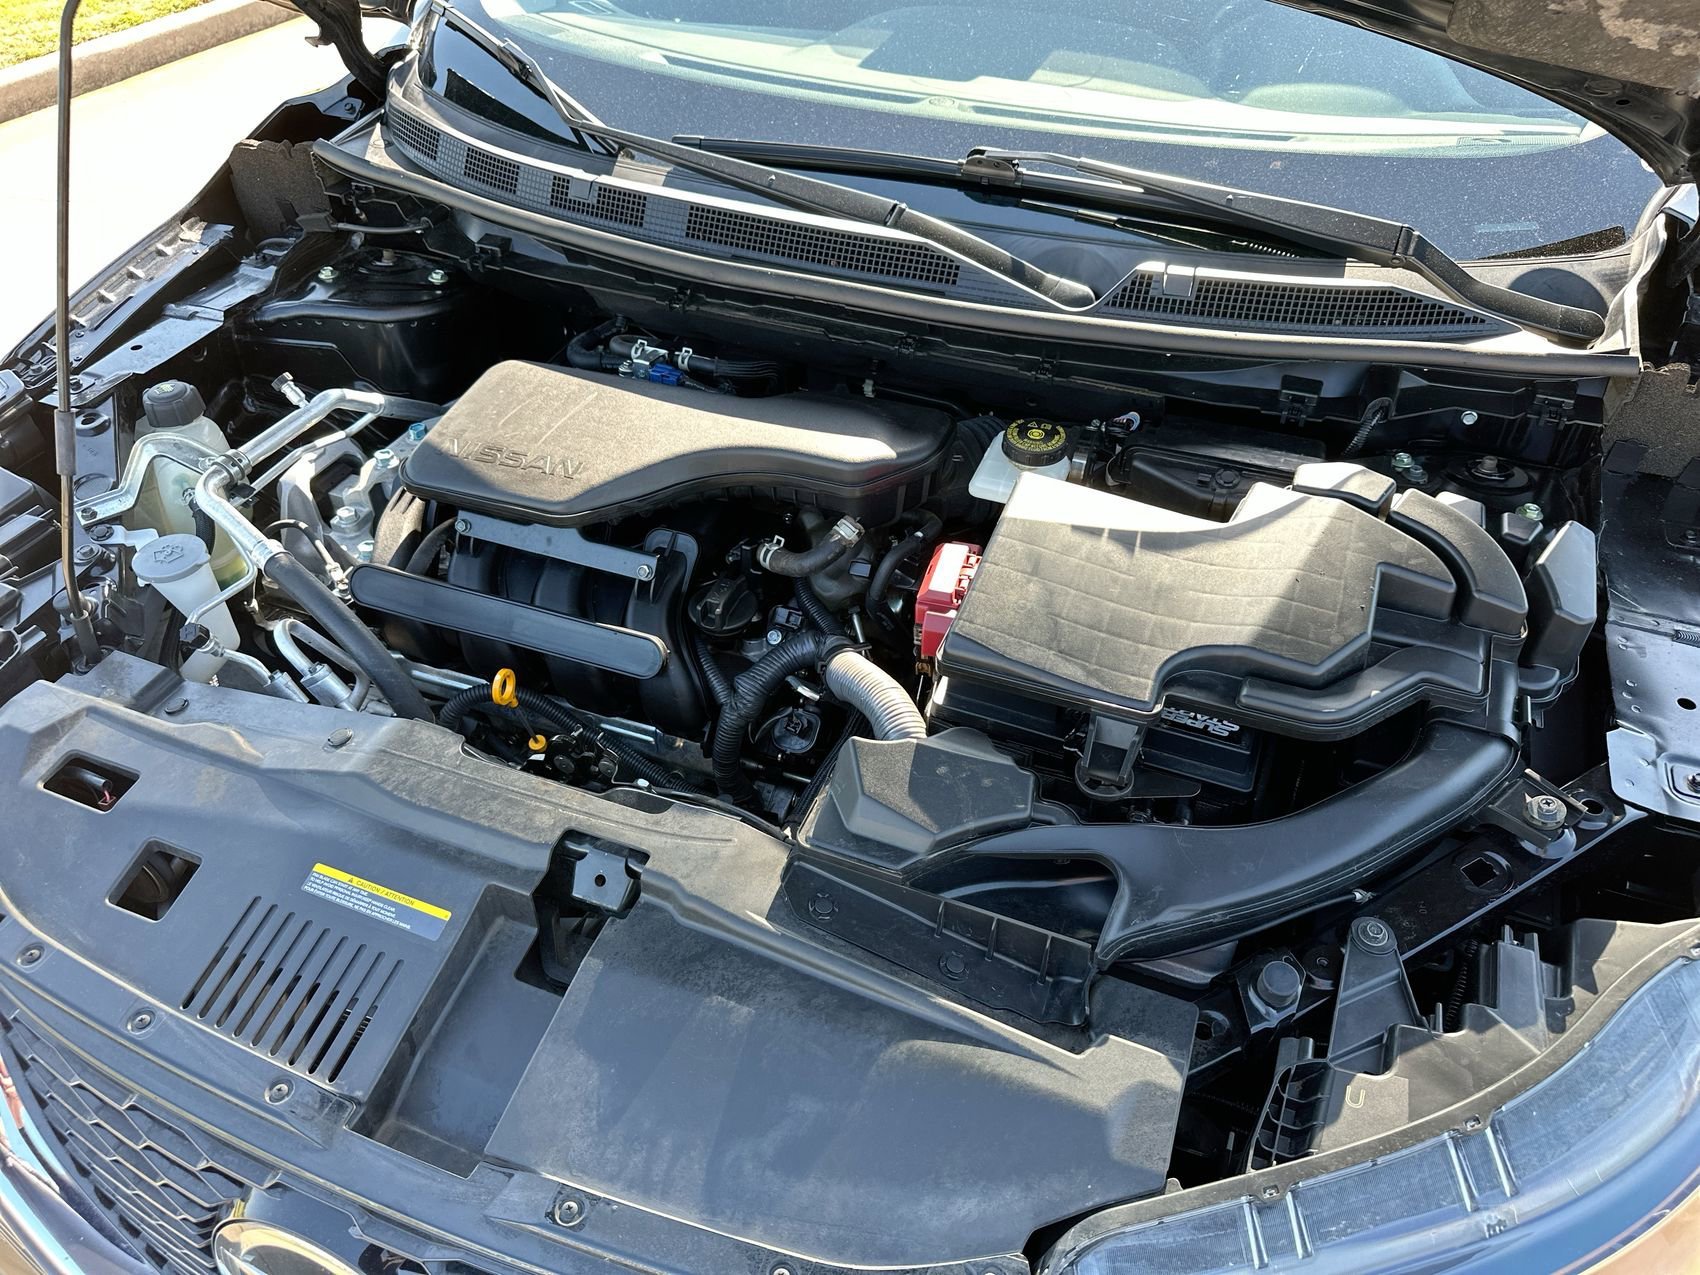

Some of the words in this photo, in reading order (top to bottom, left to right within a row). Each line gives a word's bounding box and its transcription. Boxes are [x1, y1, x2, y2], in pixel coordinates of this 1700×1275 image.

[436, 438, 584, 480] NISSAN
[1161, 710, 1231, 737] SUPER
[356, 880, 381, 893] CAUTION
[384, 891, 415, 906] ATTENTION
